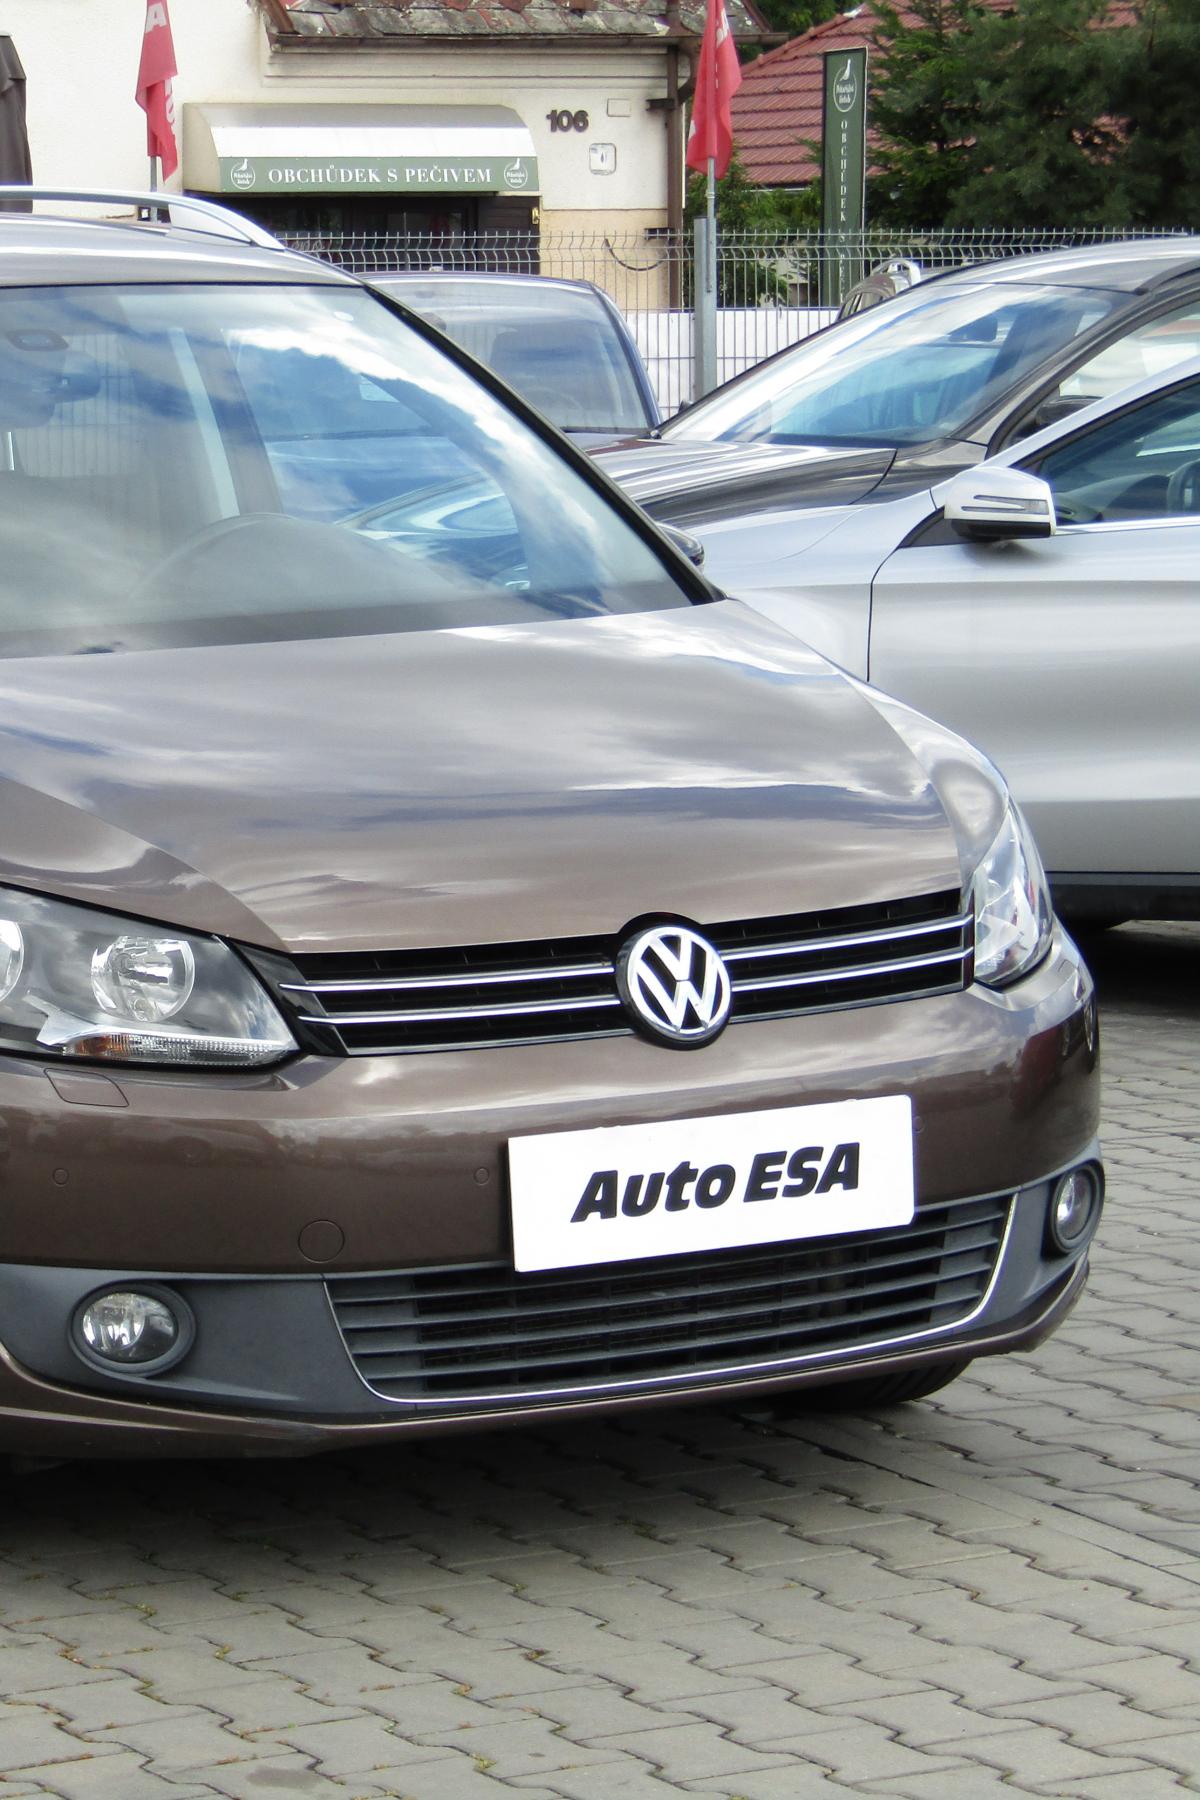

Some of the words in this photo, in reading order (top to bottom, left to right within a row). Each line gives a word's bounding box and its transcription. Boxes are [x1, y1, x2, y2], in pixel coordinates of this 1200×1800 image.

[546, 109, 589, 133] 106
[268, 165, 381, 183] OBCHŮDEK
[387, 168, 398, 183] S
[405, 165, 492, 183] PEČIVEM
[570, 1161, 736, 1223] Auto
[743, 1142, 860, 1202] ESA
